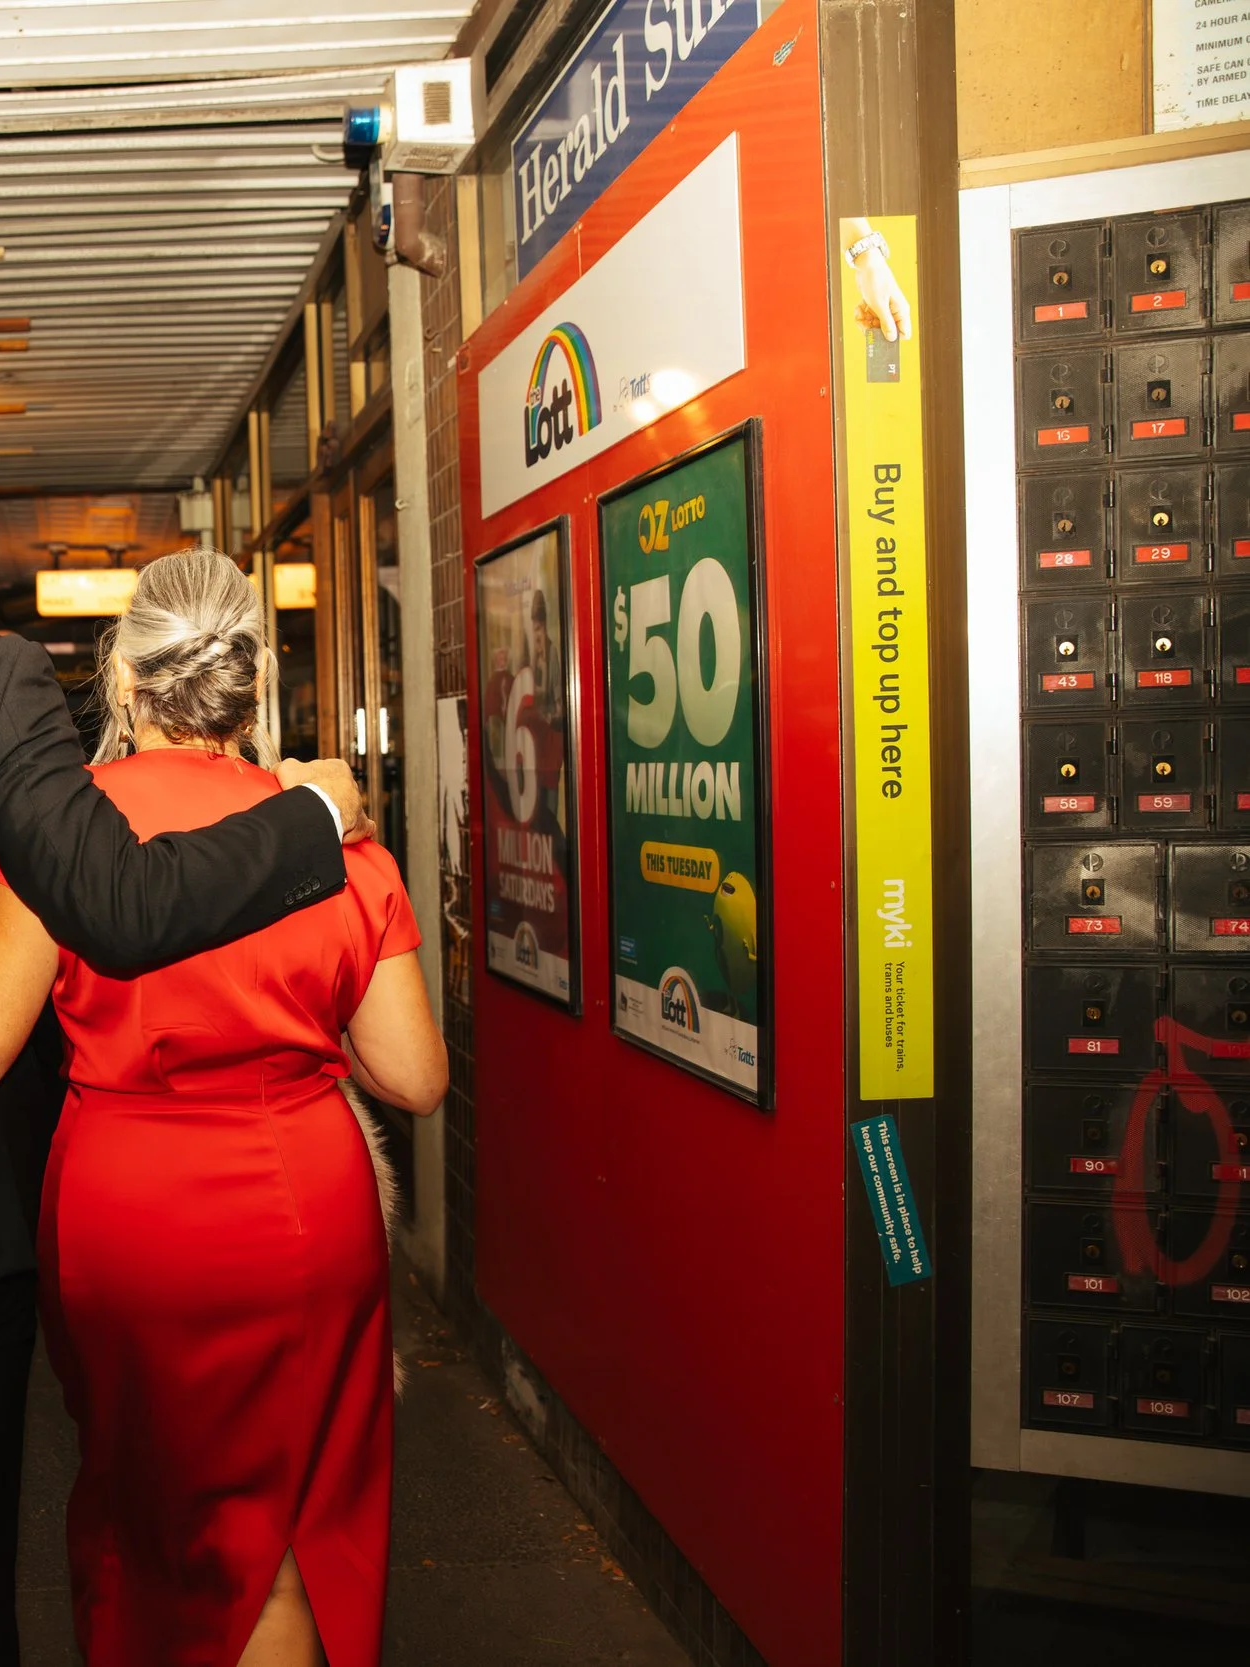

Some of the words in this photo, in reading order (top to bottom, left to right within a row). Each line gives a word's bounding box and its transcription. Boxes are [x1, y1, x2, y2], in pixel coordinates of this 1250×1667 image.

[1196, 21, 1207, 30] 24
[1210, 15, 1238, 27] HOUR
[1196, 36, 1243, 52] MINIMUM
[1197, 62, 1221, 74] SAFE
[1224, 59, 1244, 70] CAN
[1197, 77, 1209, 86] BY
[1212, 71, 1247, 84] ARMED
[1196, 97, 1219, 108] TIME
[518, 33, 630, 245] Herald
[1153, 295, 1162, 307] 2
[1058, 306, 1064, 317] 1
[1152, 423, 1165, 434] 17
[867, 464, 902, 525] Buy
[671, 494, 706, 532] LOTTO
[1054, 554, 1074, 565] 28
[1151, 548, 1171, 559] 29
[876, 537, 905, 597] and
[871, 607, 903, 663] top
[614, 557, 742, 749] $50
[1058, 676, 1077, 687] 43
[1154, 673, 1172, 684] 118
[872, 673, 901, 714] up
[880, 724, 908, 799] here
[625, 761, 742, 822] MILLION
[1059, 799, 1078, 810] 58
[1153, 798, 1173, 808] 59
[497, 828, 554, 875] MILLION
[645, 852, 665, 873] THIS
[666, 856, 713, 881] TUESDAY
[499, 871, 556, 913] SATURDAYS
[877, 878, 912, 949] myki
[1085, 920, 1103, 931] 73
[1230, 921, 1250, 932] 74
[885, 962, 893, 993] trams
[895, 961, 905, 985] Your
[885, 996, 894, 1015] and
[896, 988, 906, 1018] ticket
[885, 1017, 894, 1048] buses
[896, 1021, 906, 1036] for
[895, 1040, 906, 1072] trains,
[1086, 1041, 1101, 1052] 81
[738, 1047, 756, 1067] Tatts
[860, 1126, 873, 1153] keep
[878, 1121, 889, 1145] This
[868, 1154, 879, 1174] our
[884, 1145, 899, 1183] screen
[1085, 1161, 1105, 1172] 90
[893, 1183, 901, 1193] is
[873, 1174, 895, 1236] community
[895, 1194, 906, 1206] in
[898, 1206, 912, 1236] place
[889, 1237, 901, 1263] safe.
[907, 1236, 916, 1249] to
[910, 1249, 922, 1274] help
[1084, 1279, 1103, 1290] 101
[1226, 1289, 1250, 1300] 102
[1056, 1394, 1080, 1405] 107
[1150, 1402, 1174, 1414] 108
